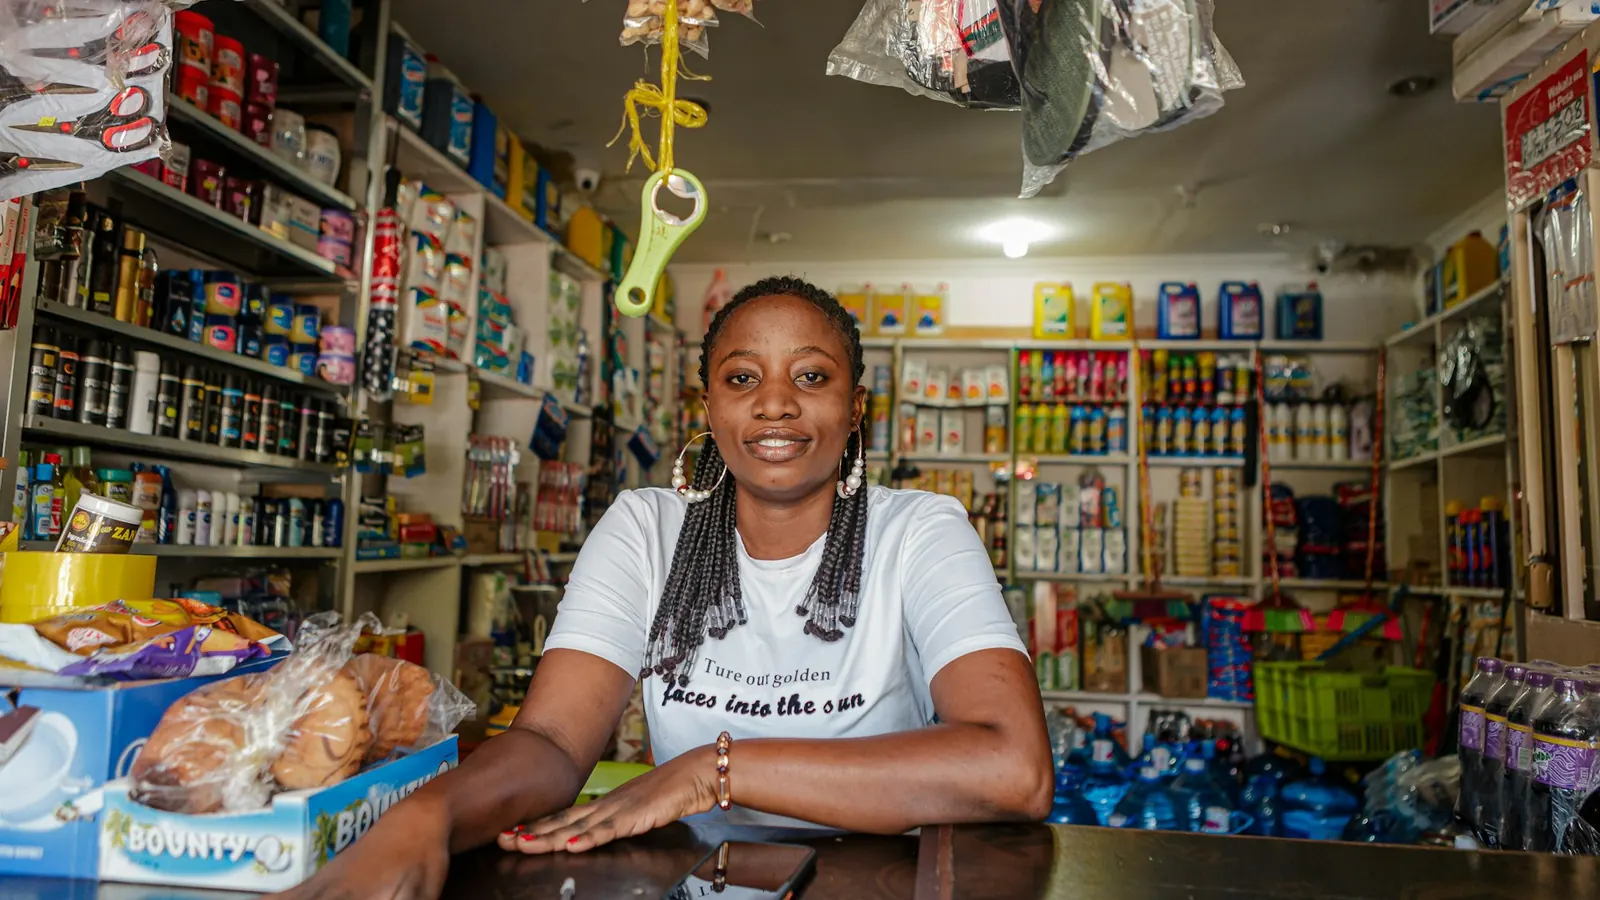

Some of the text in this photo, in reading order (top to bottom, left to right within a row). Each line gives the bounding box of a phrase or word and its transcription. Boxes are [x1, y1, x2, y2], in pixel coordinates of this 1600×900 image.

[704, 657, 831, 688] Ture out golden
[661, 680, 866, 718] faces into the sun
[129, 824, 249, 862] BOUNTY
